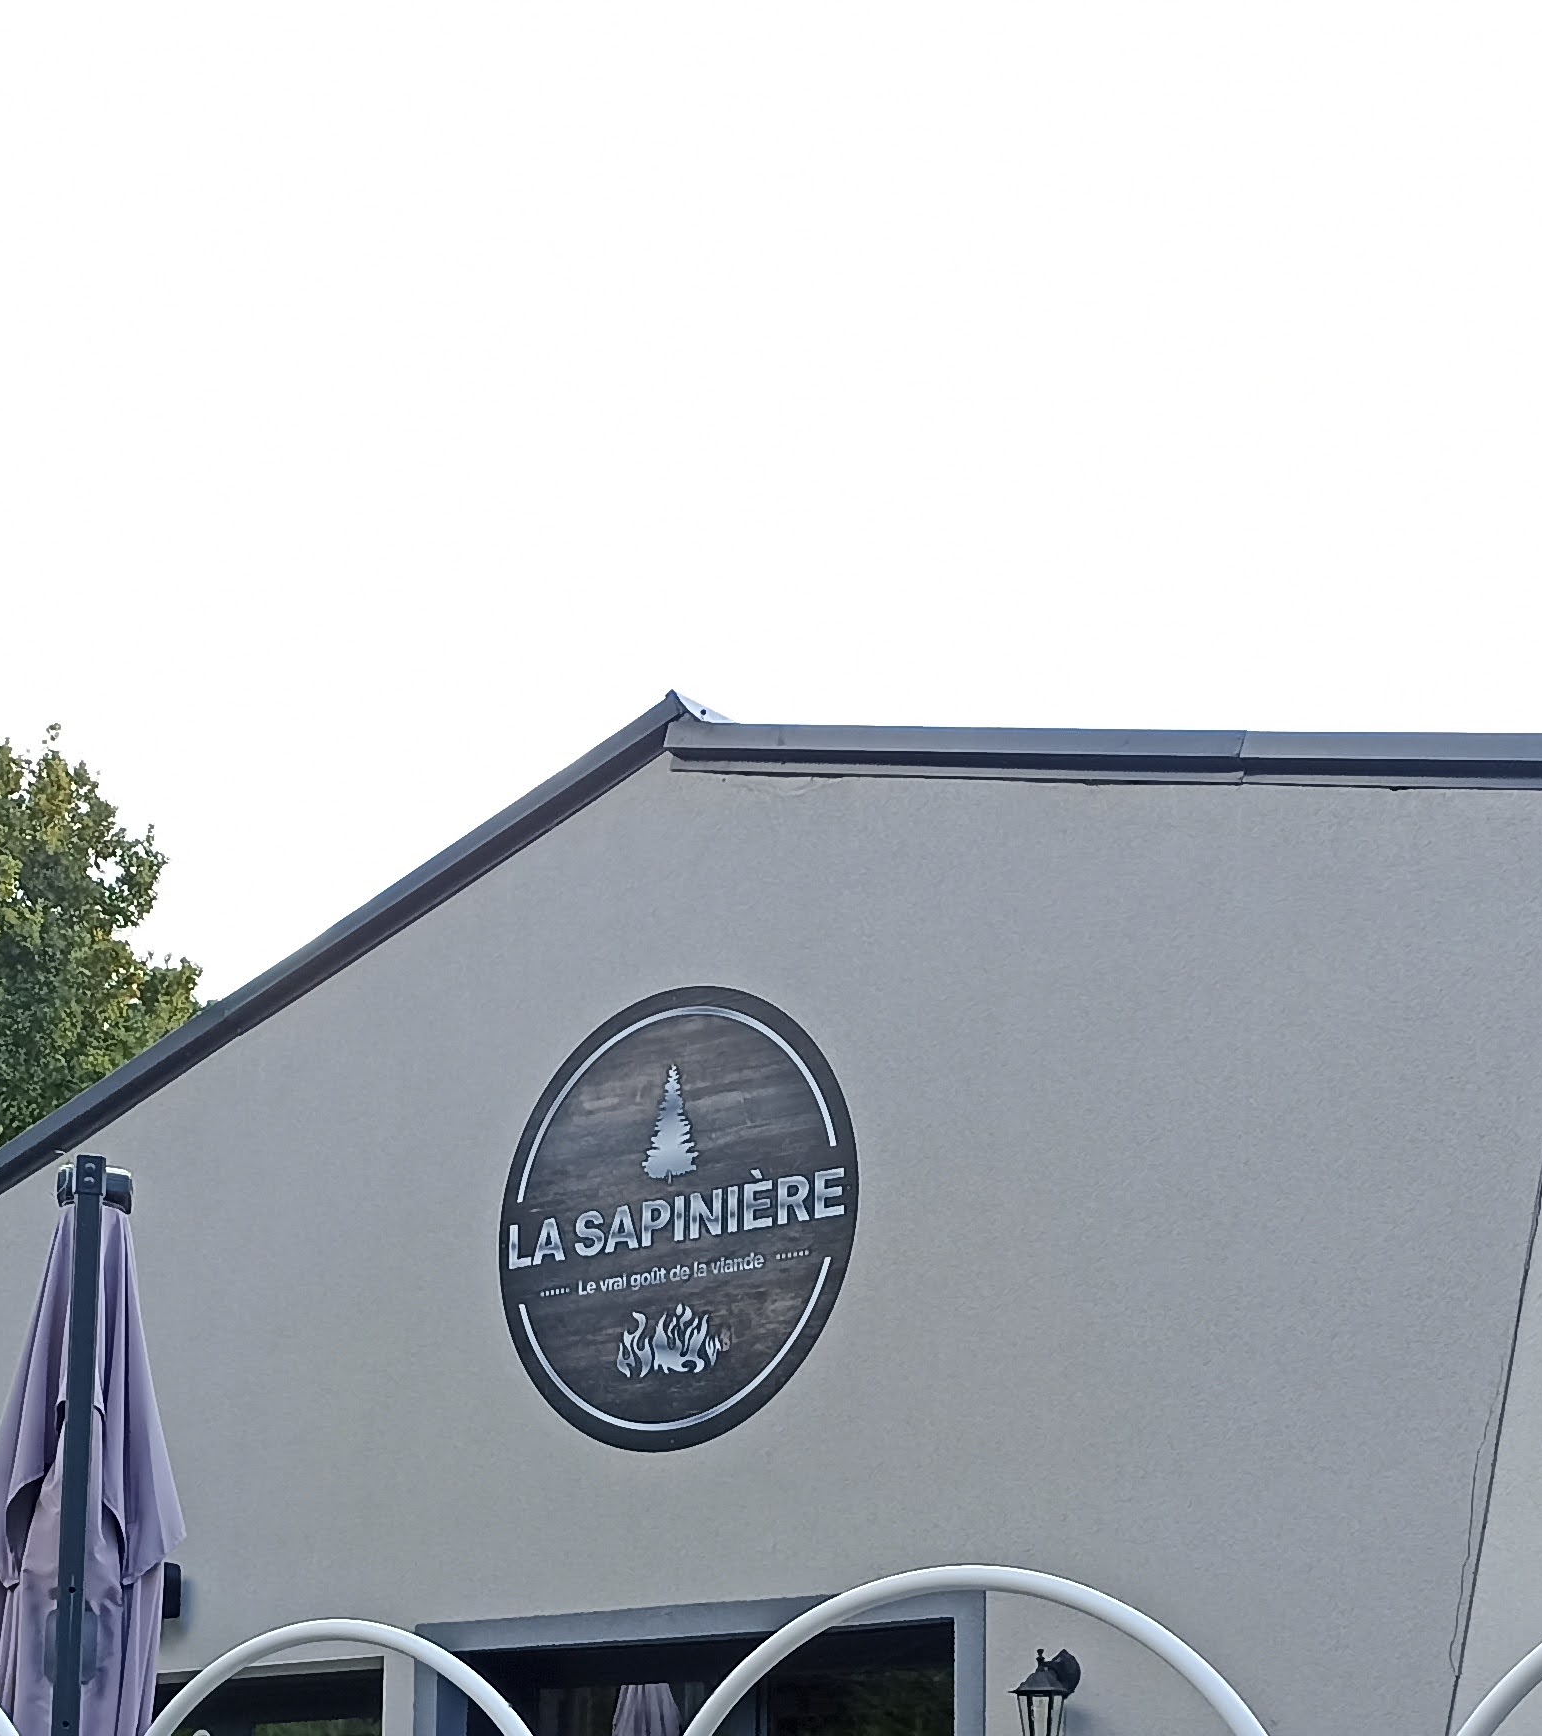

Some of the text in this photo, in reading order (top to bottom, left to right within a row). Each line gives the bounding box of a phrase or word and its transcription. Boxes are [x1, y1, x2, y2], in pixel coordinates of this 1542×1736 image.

[508, 1168, 845, 1269] LA SAPINIÈRE
[578, 1252, 765, 1296] Le vrai goût de la viande
